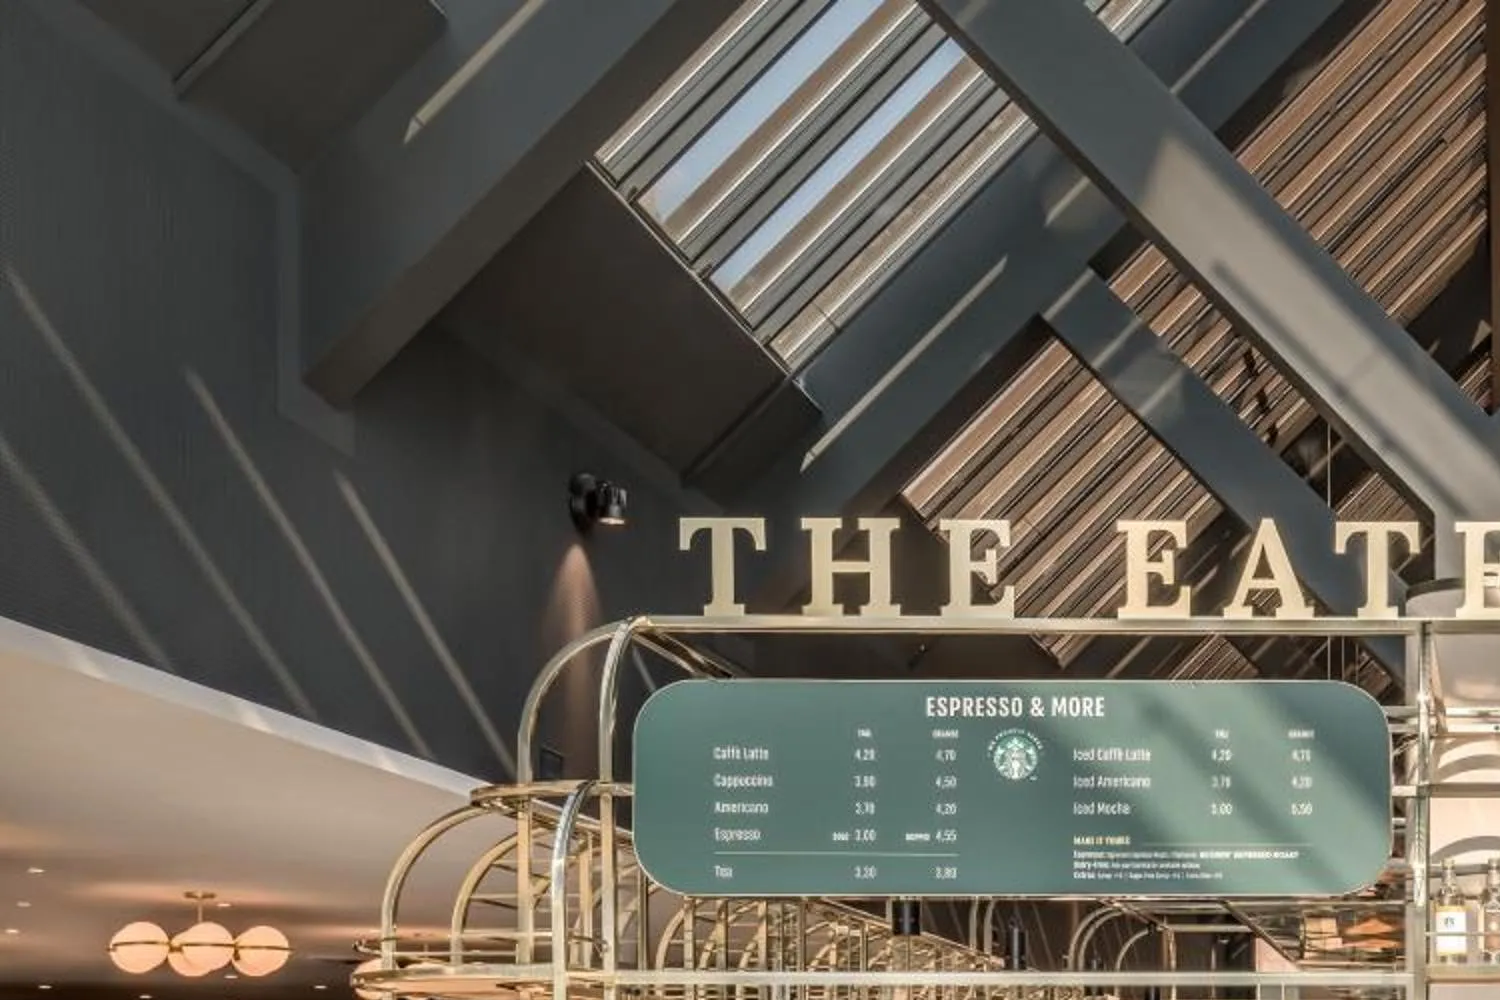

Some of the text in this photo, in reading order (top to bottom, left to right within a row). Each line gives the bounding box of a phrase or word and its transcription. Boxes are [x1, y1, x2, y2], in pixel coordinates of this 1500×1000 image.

[679, 517, 1014, 617] THE
[926, 696, 1104, 717] ESPRESSO & MORE
